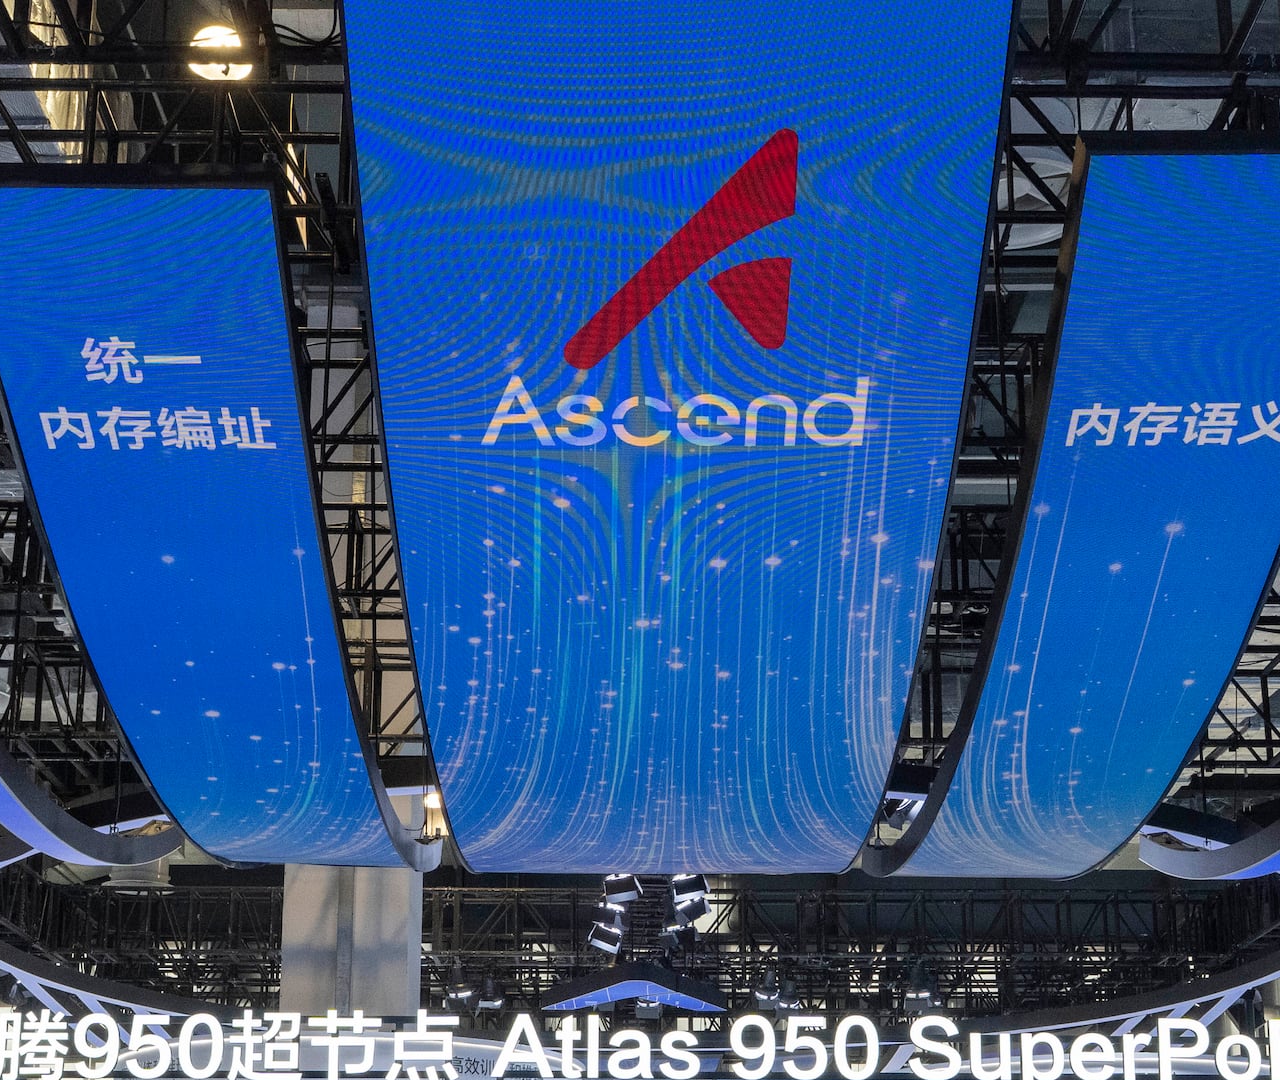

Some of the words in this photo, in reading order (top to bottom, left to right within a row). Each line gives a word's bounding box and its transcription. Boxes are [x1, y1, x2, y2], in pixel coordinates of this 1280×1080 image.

[81, 336, 202, 384] 统一
[39, 406, 277, 450] 内存编址
[481, 375, 870, 446] Ascend
[492, 1014, 699, 1079] Atlas
[732, 1014, 880, 1080] 950
